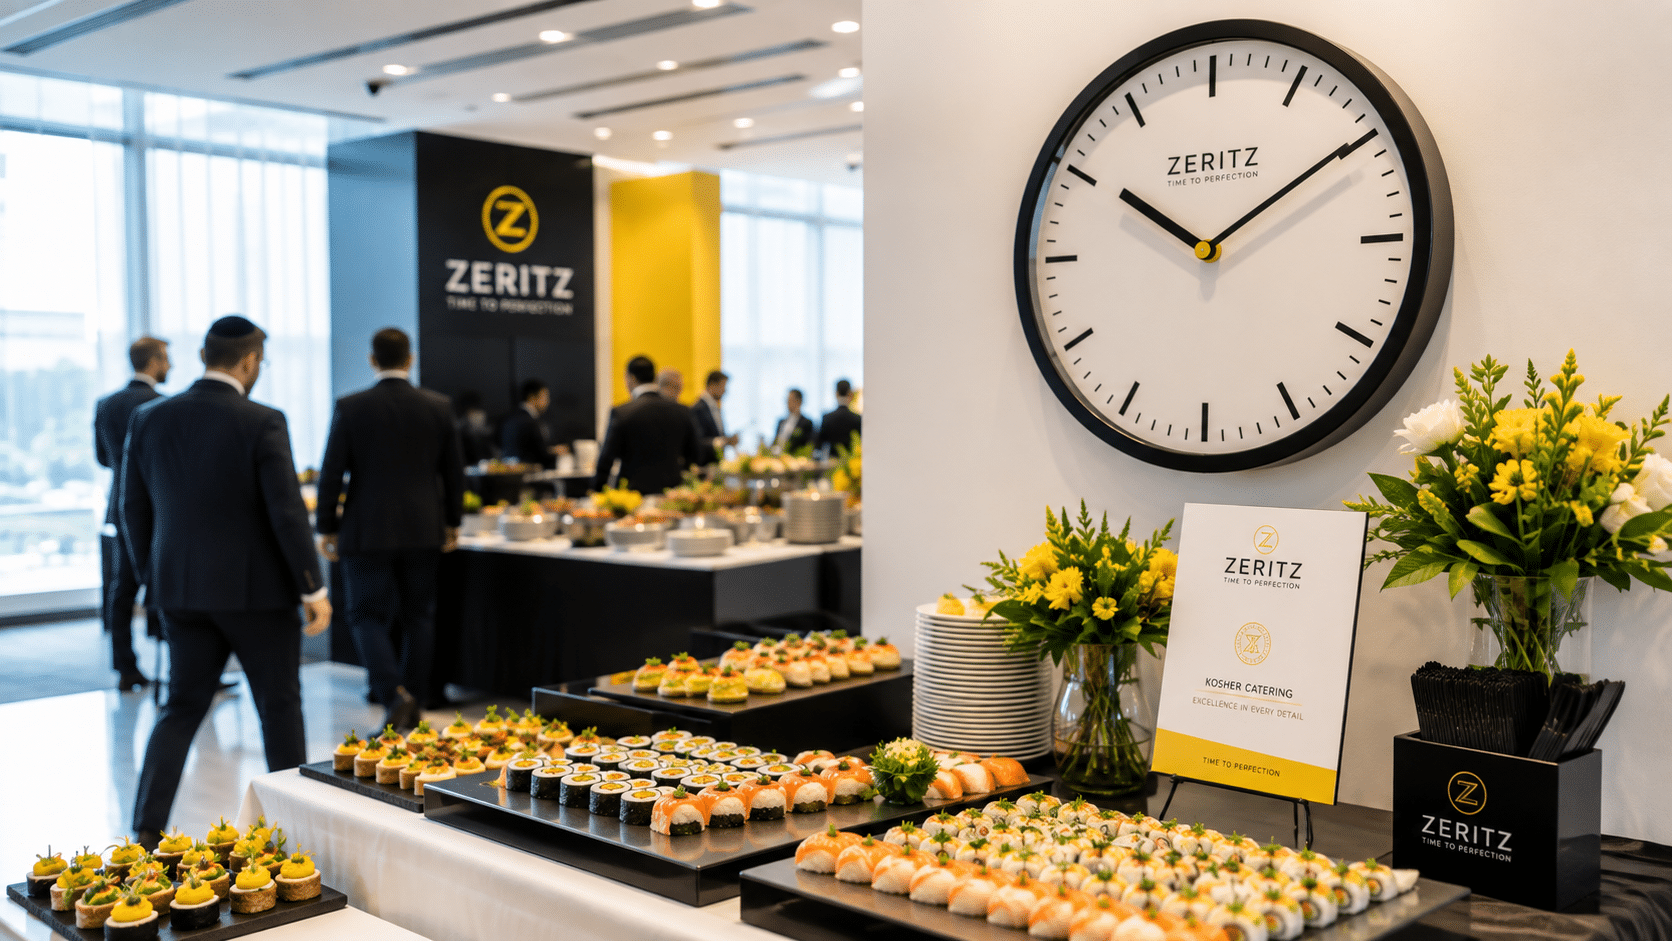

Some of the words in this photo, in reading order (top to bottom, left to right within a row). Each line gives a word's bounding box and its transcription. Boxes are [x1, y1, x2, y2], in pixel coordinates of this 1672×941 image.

[1167, 147, 1258, 175] ZERITZ
[1167, 179, 1186, 187] TIME
[1190, 177, 1201, 185] TO
[1204, 171, 1258, 182] PERFECTION
[445, 258, 574, 300] ZERITZ
[1224, 557, 1302, 579] ZERITZ
[1254, 579, 1300, 589] PERFECTION
[1205, 677, 1241, 691] KOSHER
[1245, 683, 1293, 698] CATERING
[1192, 696, 1238, 710] EXCELLENCE
[1250, 705, 1274, 715] EVERY
[1277, 709, 1304, 720] DETAIL
[1203, 757, 1219, 766] TIME
[1222, 760, 1232, 768] TO
[1234, 763, 1280, 776] PERFECTION
[1421, 814, 1512, 852] ZERITZ
[1422, 836, 1441, 847] TIME
[1444, 841, 1455, 850] TO
[1458, 845, 1512, 862] PERFECTION
